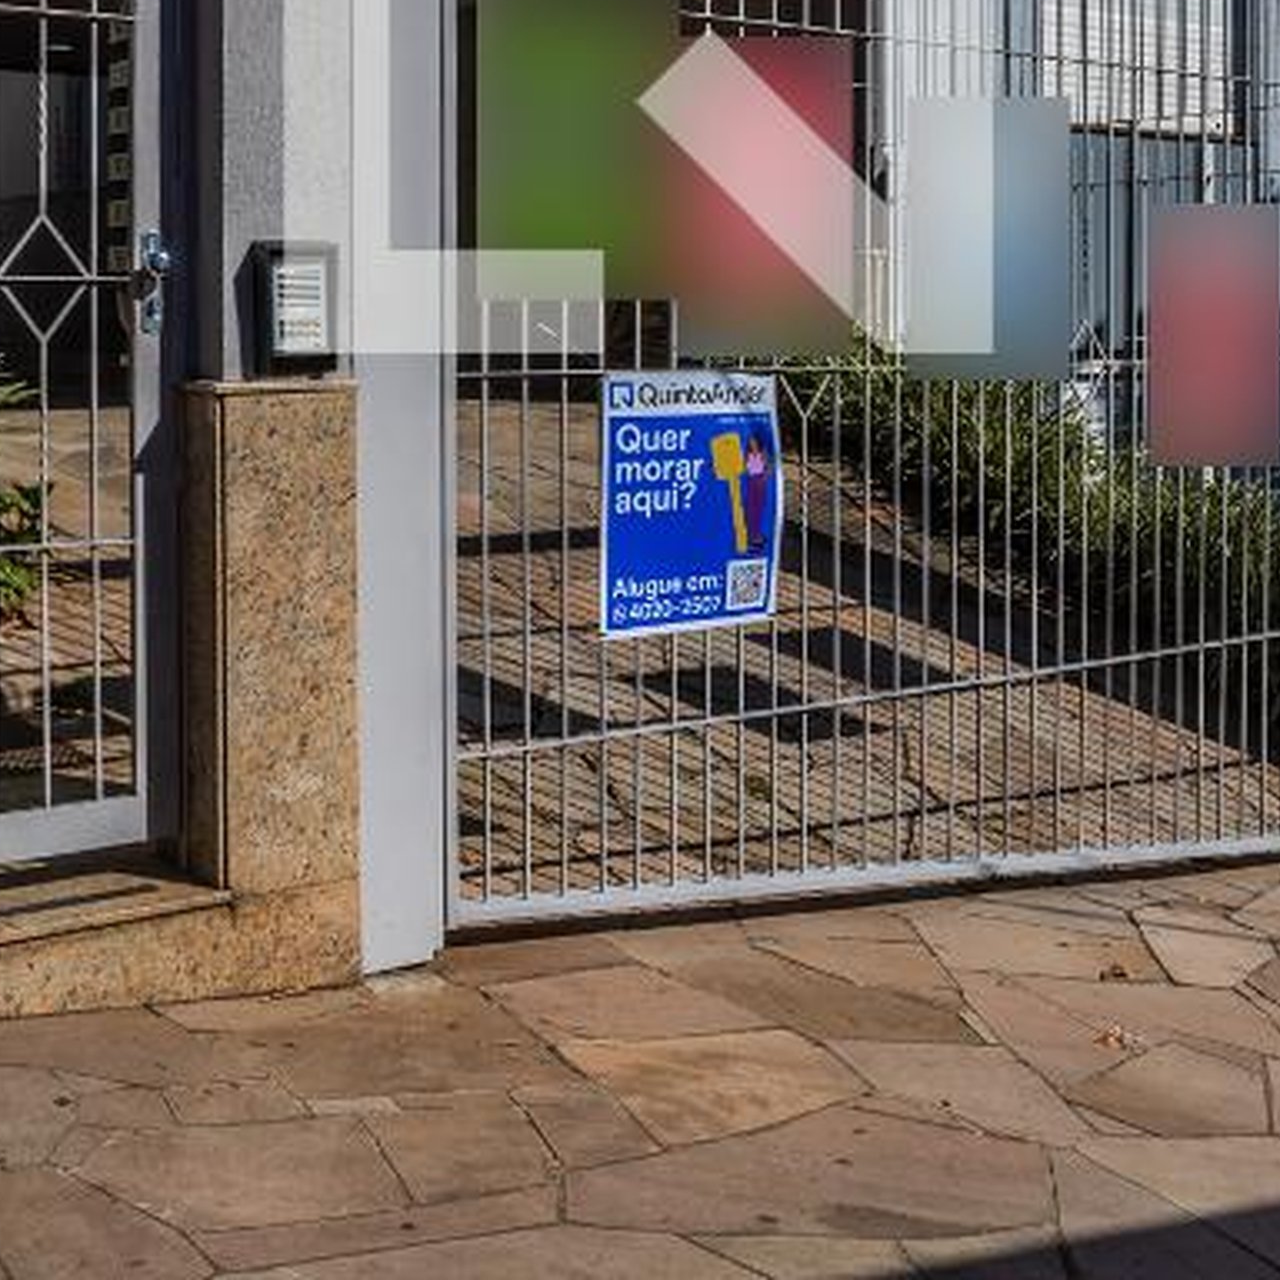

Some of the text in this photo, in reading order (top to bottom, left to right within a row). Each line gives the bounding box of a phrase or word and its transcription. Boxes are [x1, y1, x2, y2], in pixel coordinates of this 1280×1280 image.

[616, 423, 691, 454] Quer
[615, 458, 704, 484] morar
[615, 480, 697, 518] aqui?
[613, 577, 682, 601] Alugue
